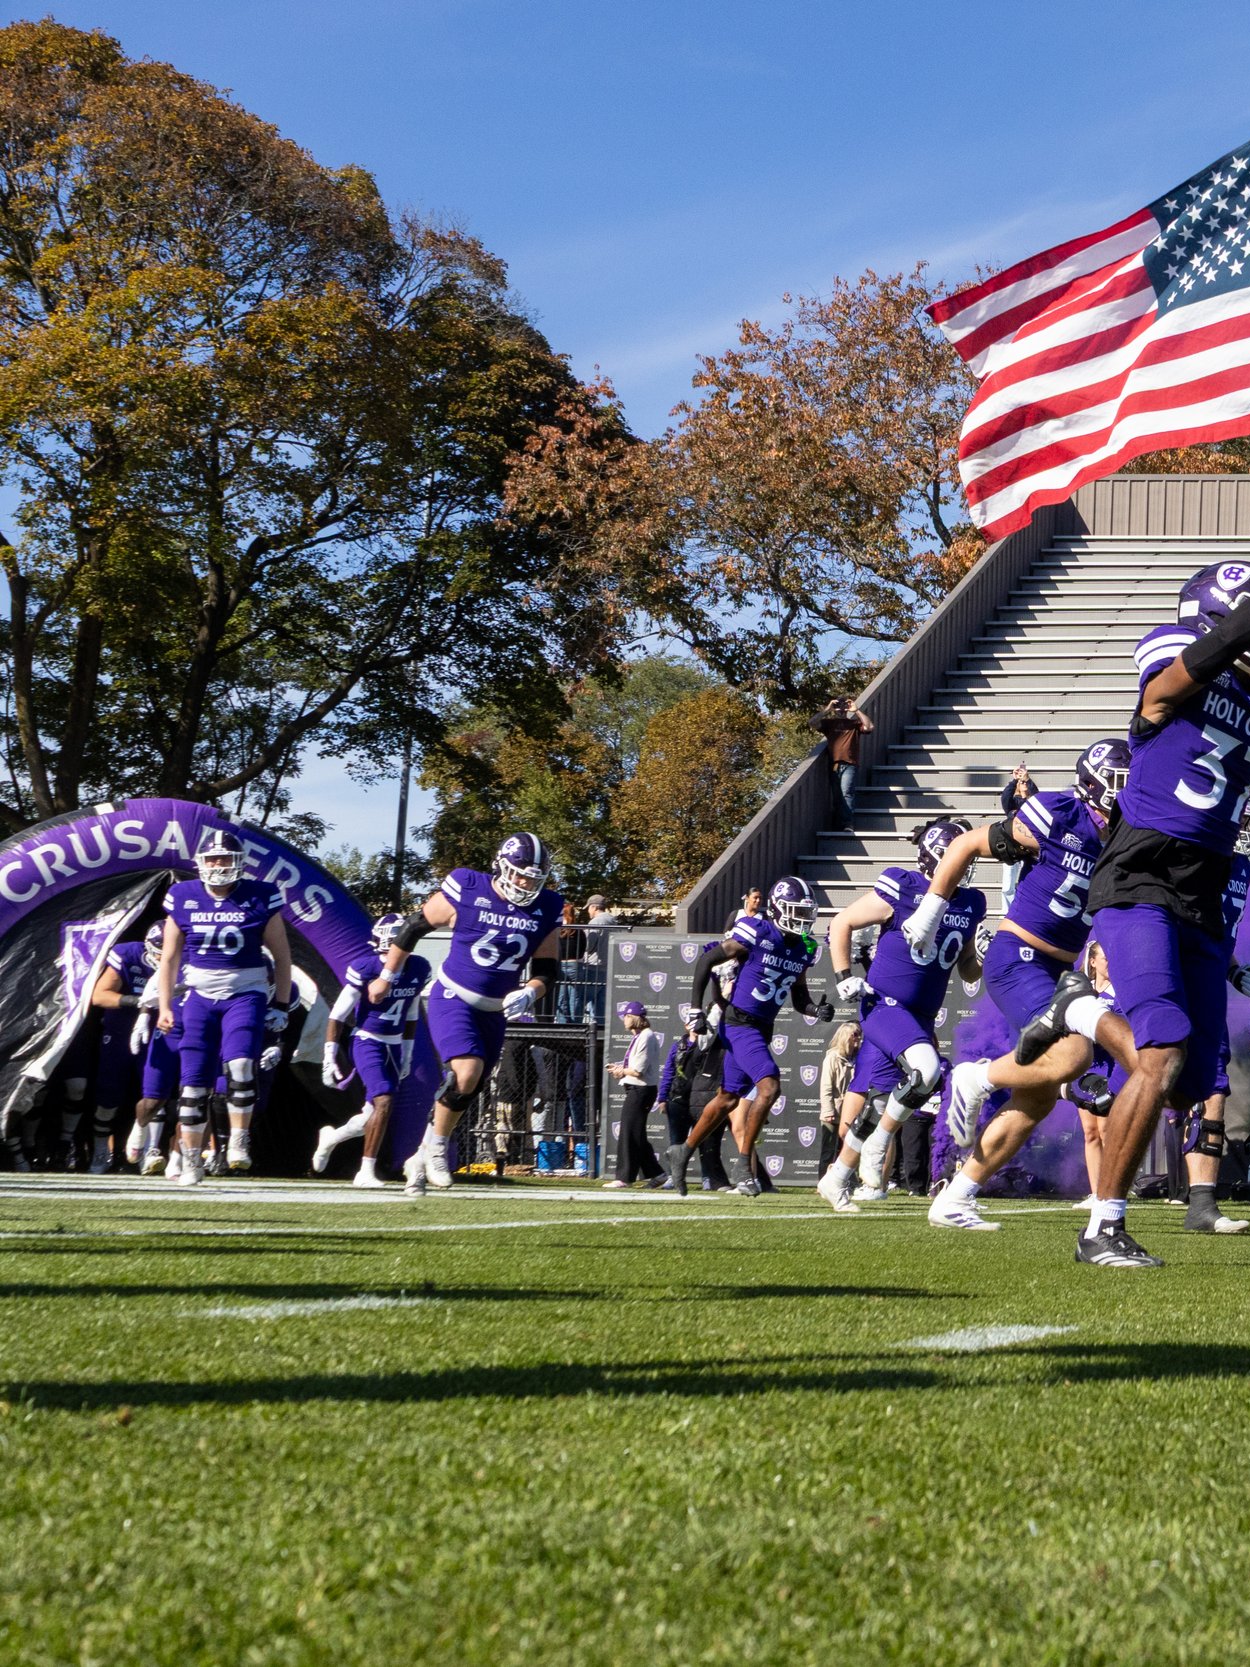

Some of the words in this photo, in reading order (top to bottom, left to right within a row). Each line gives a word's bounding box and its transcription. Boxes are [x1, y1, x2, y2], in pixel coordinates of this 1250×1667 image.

[1203, 691, 1246, 729] HOLY
[1061, 851, 1095, 876] HOLY
[1048, 871, 1093, 927] 5
[1227, 879, 1247, 895] CROSS
[190, 912, 213, 922] HOLY
[213, 912, 245, 923] CROSS
[478, 910, 505, 927] HOLY
[505, 916, 539, 932] CROSS
[943, 914, 970, 929] CROSS
[192, 925, 245, 955] 70
[470, 929, 528, 972] 62
[762, 953, 783, 968] HOLY
[783, 960, 804, 973] CROSS
[393, 987, 416, 998] CROSS
[751, 967, 796, 1006] 38
[378, 999, 406, 1026] 4
